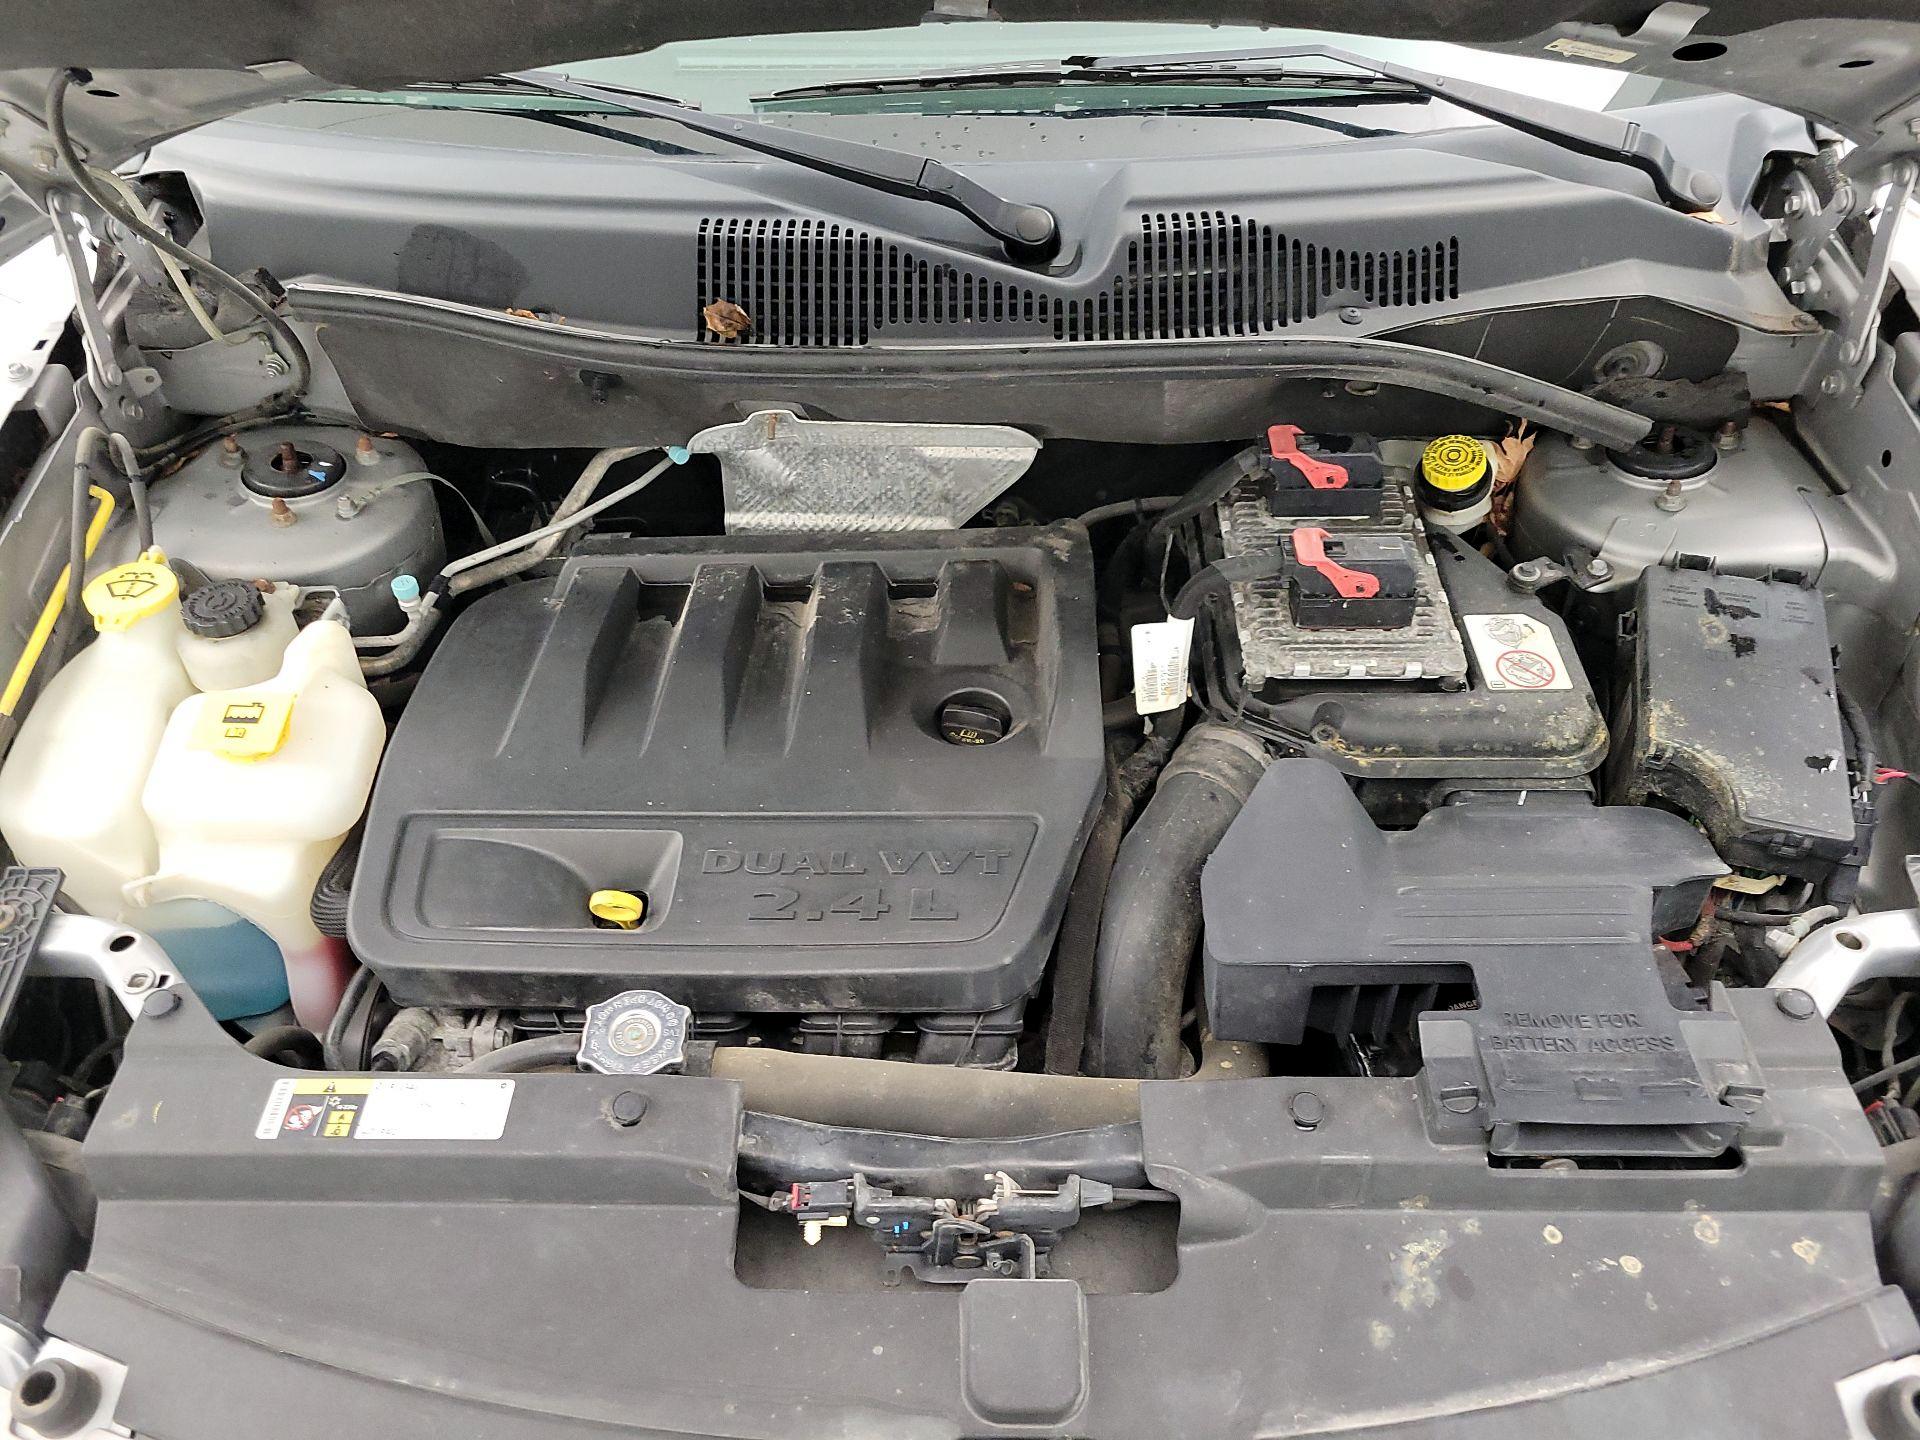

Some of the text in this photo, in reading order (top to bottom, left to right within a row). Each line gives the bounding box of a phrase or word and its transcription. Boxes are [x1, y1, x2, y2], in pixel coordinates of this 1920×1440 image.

[702, 849, 1009, 874] DUAL VVT
[749, 887, 959, 921] 2.4 L
[1447, 999, 1478, 1010] DANGE
[1503, 1012, 1643, 1029] REMOVE FOR
[1491, 1035, 1675, 1052] BATTERY ACCESS
